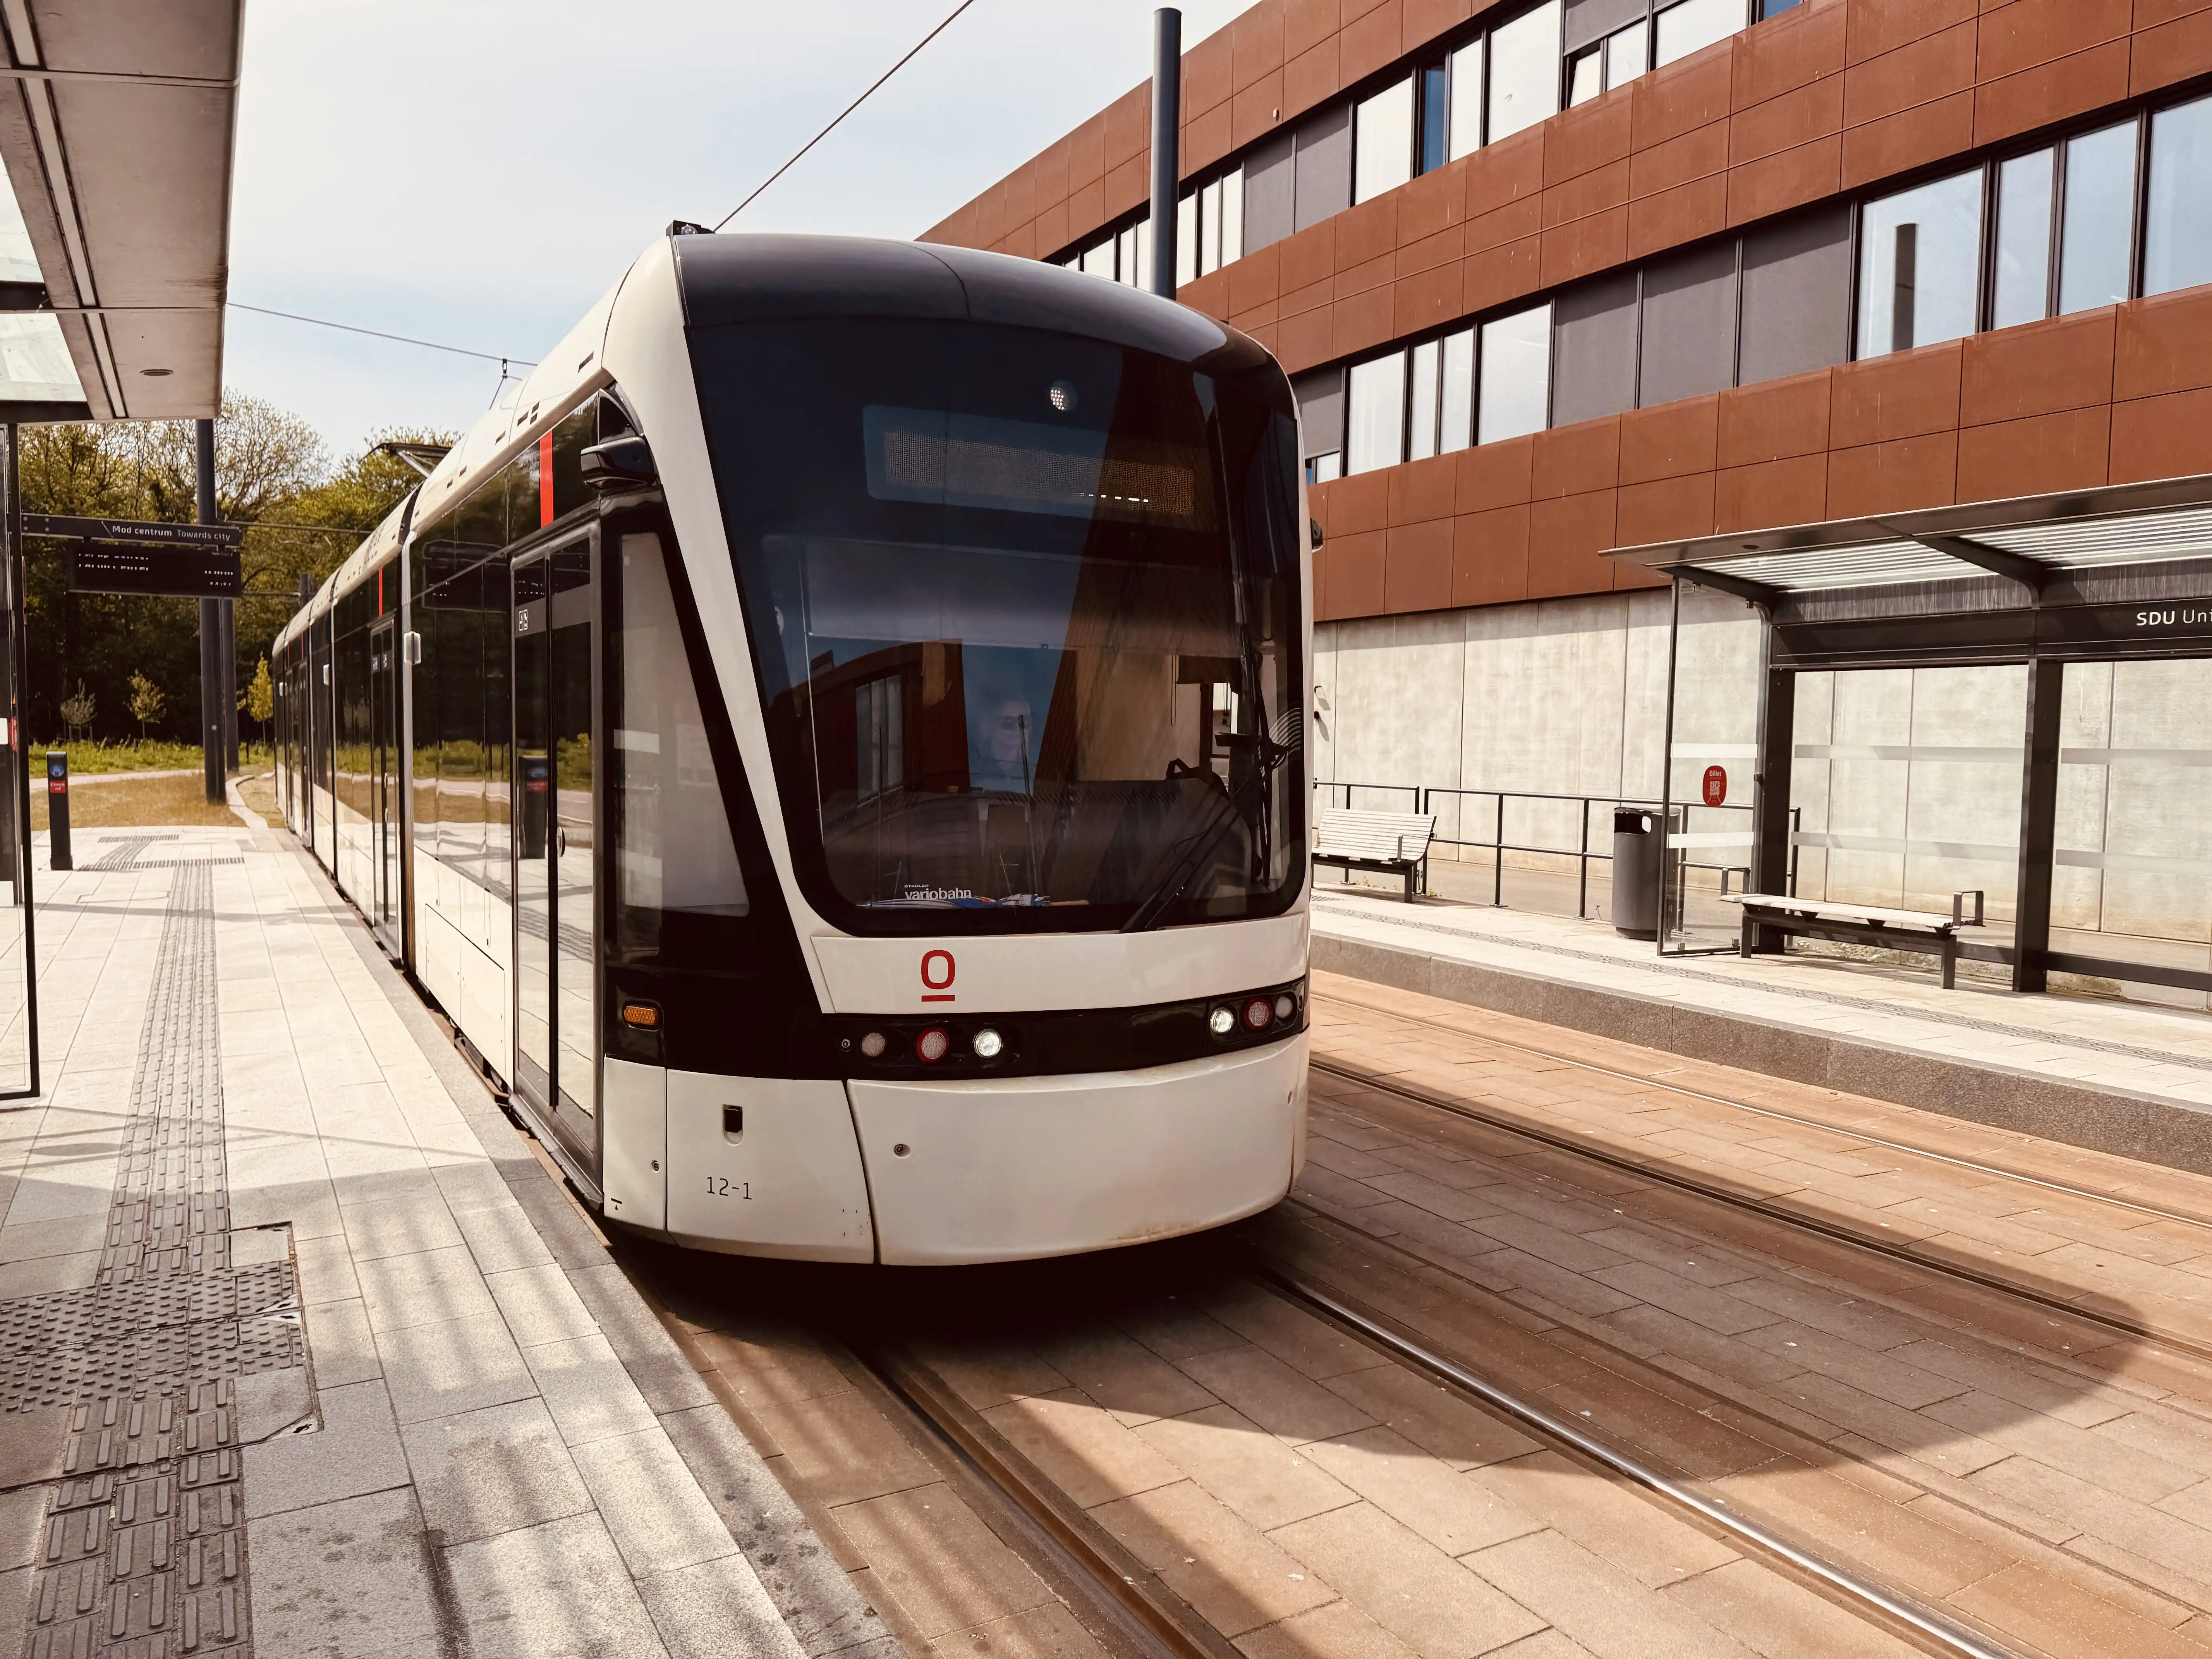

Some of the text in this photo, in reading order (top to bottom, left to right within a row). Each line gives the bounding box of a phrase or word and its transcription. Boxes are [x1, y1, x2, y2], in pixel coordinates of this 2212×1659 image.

[112, 525, 230, 541] Mod centrum Towards city
[2136, 611, 2175, 626] SDU
[905, 888, 972, 900] variobahn
[707, 1176, 752, 1200] 12-1
